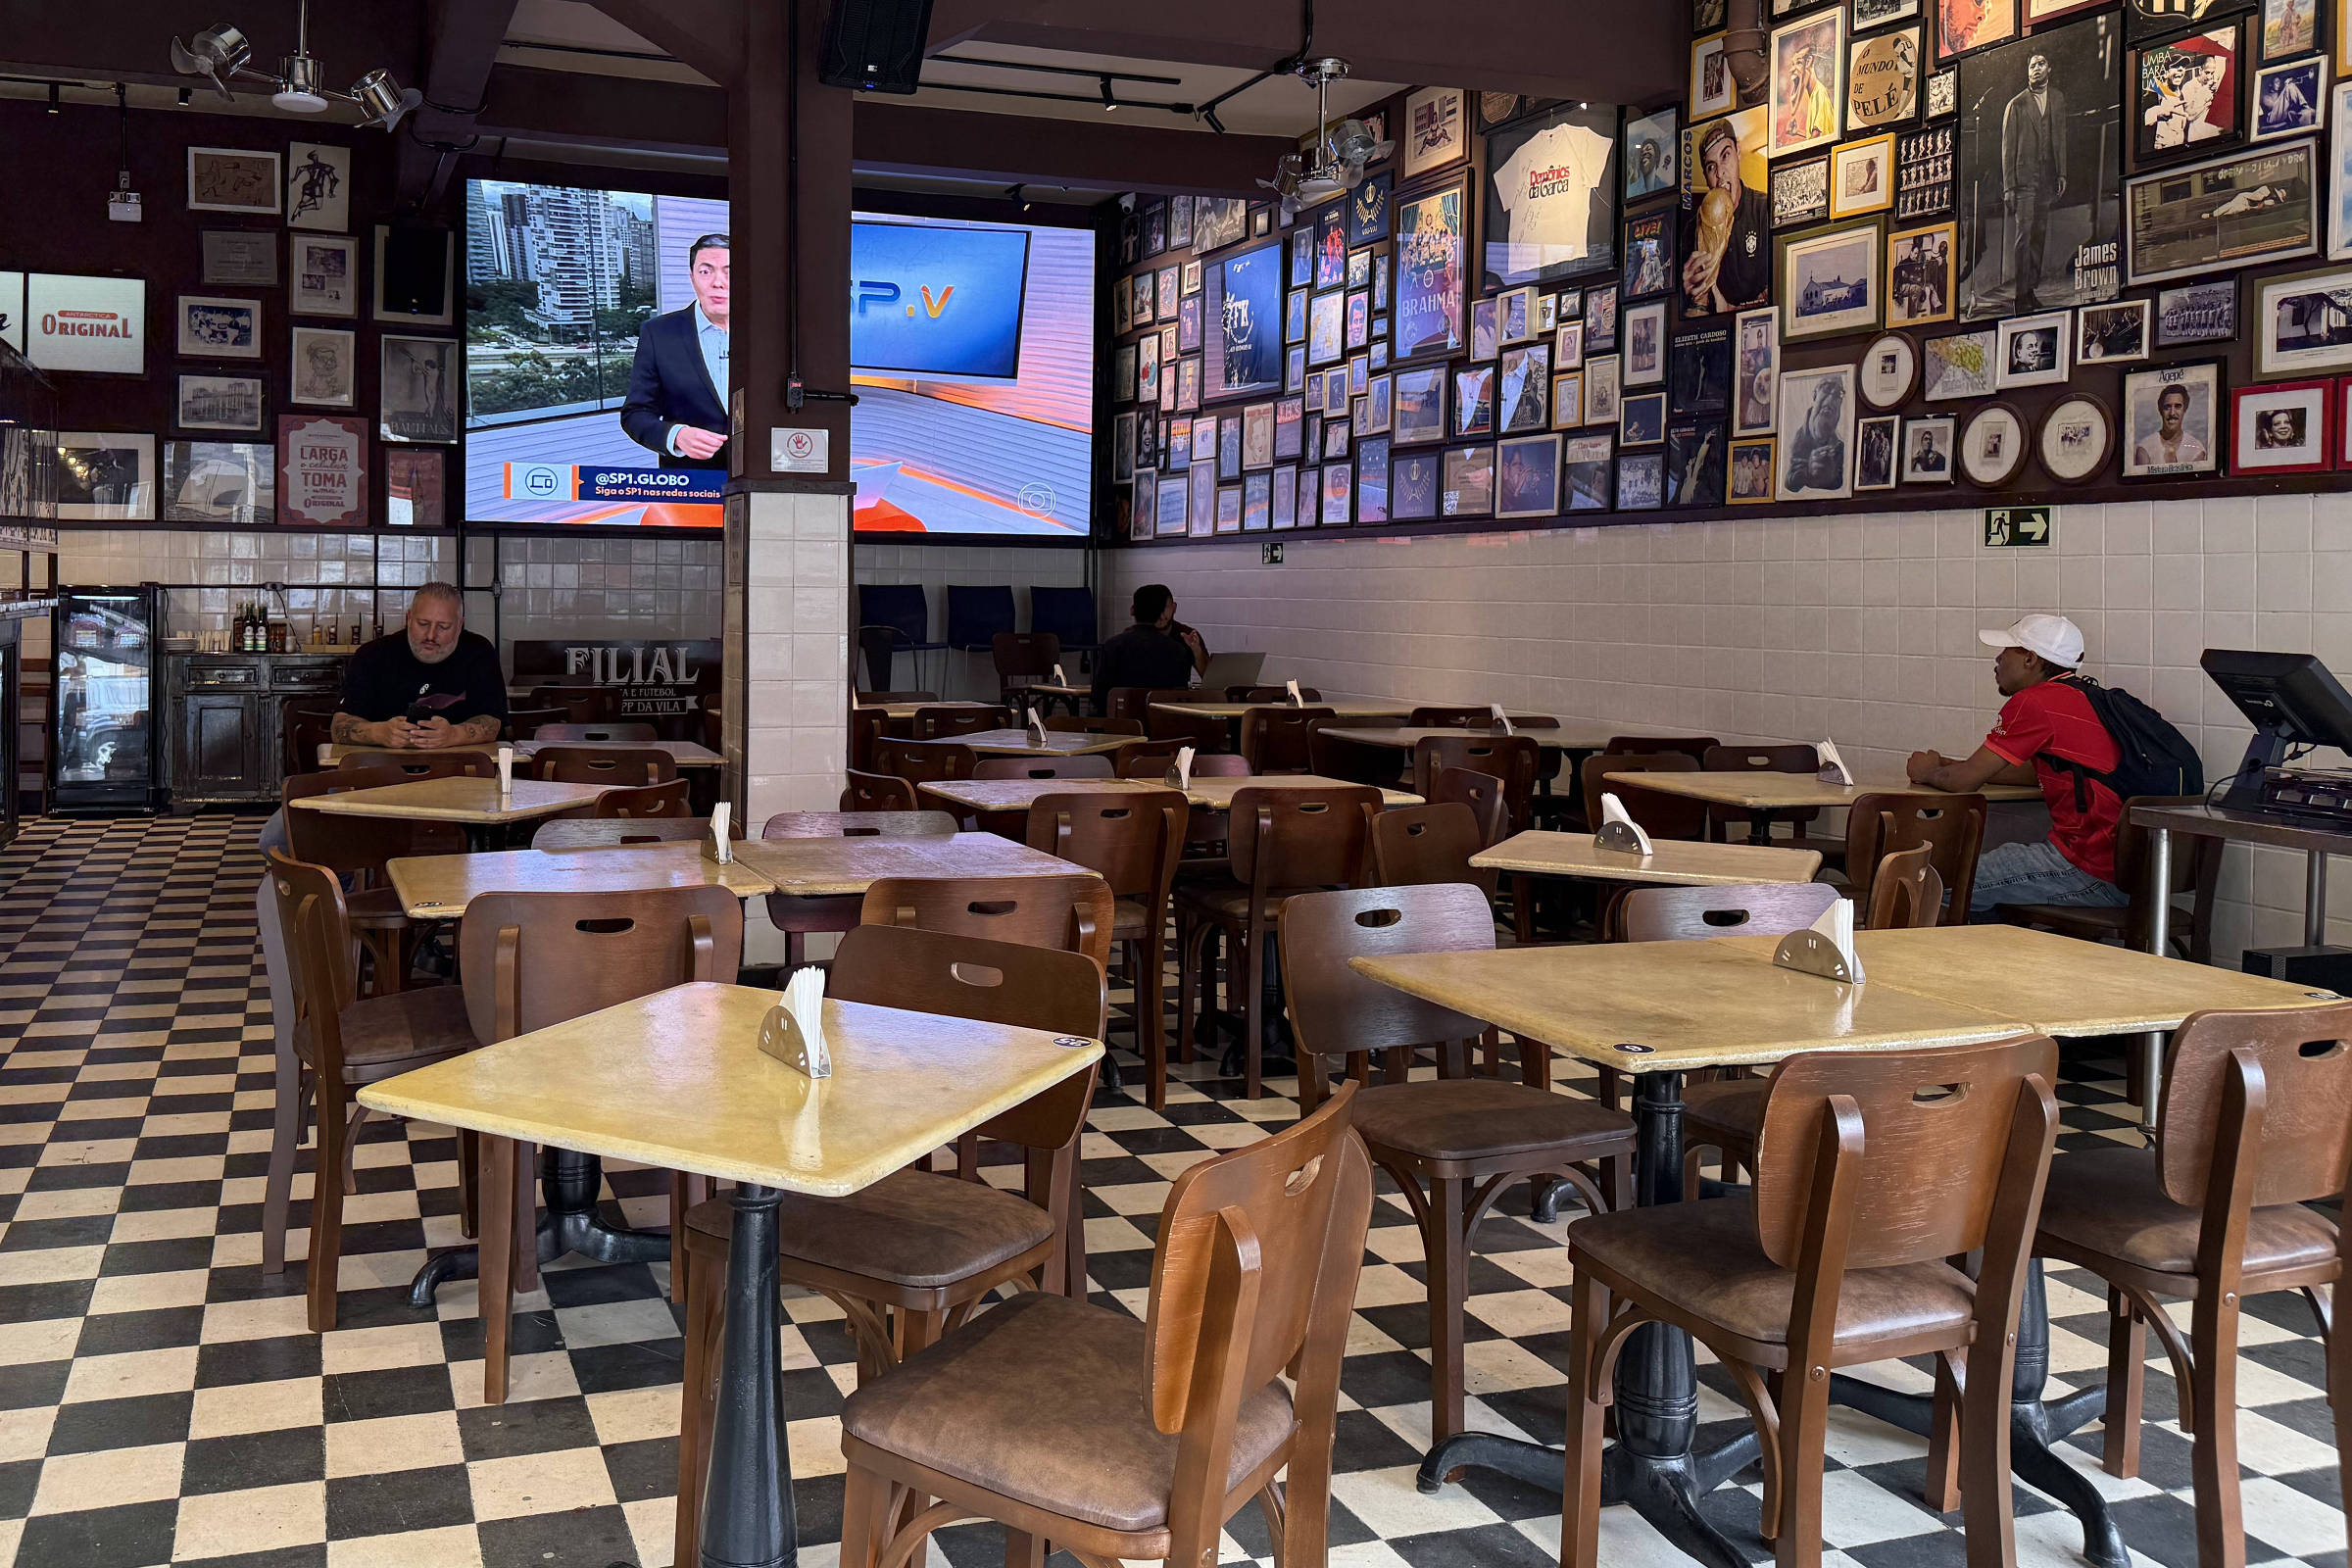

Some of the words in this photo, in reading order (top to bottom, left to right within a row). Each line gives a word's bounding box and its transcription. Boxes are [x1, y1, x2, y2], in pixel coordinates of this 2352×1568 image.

[1863, 48, 1870, 59] O
[2142, 51, 2172, 68] UMBA
[1857, 59, 1894, 76] MUNDO
[2141, 64, 2167, 79] BARA
[1854, 82, 1865, 94] DE
[1853, 82, 1899, 117] PELÉ
[1683, 130, 1692, 211] MARCOS
[2074, 242, 2117, 268] James
[2074, 265, 2117, 290] Brown
[850, 280, 955, 318] P.V
[1402, 289, 1455, 318] BRAHMA
[42, 314, 132, 338] ORIGINAL
[1699, 329, 1727, 340] CARDOSO
[2159, 368, 2184, 383] Agepé
[300, 447, 348, 462] LARGA
[301, 472, 347, 487] TOMA
[595, 472, 690, 486] @SP1.GLOBO
[595, 486, 618, 497] Siga
[625, 487, 642, 496] SP1
[662, 488, 688, 497] redes
[689, 489, 721, 498] sociais
[564, 647, 700, 685] FILIAL
[639, 688, 676, 697] FUTEBOL
[637, 702, 653, 712] DA
[656, 701, 680, 711] VILA
